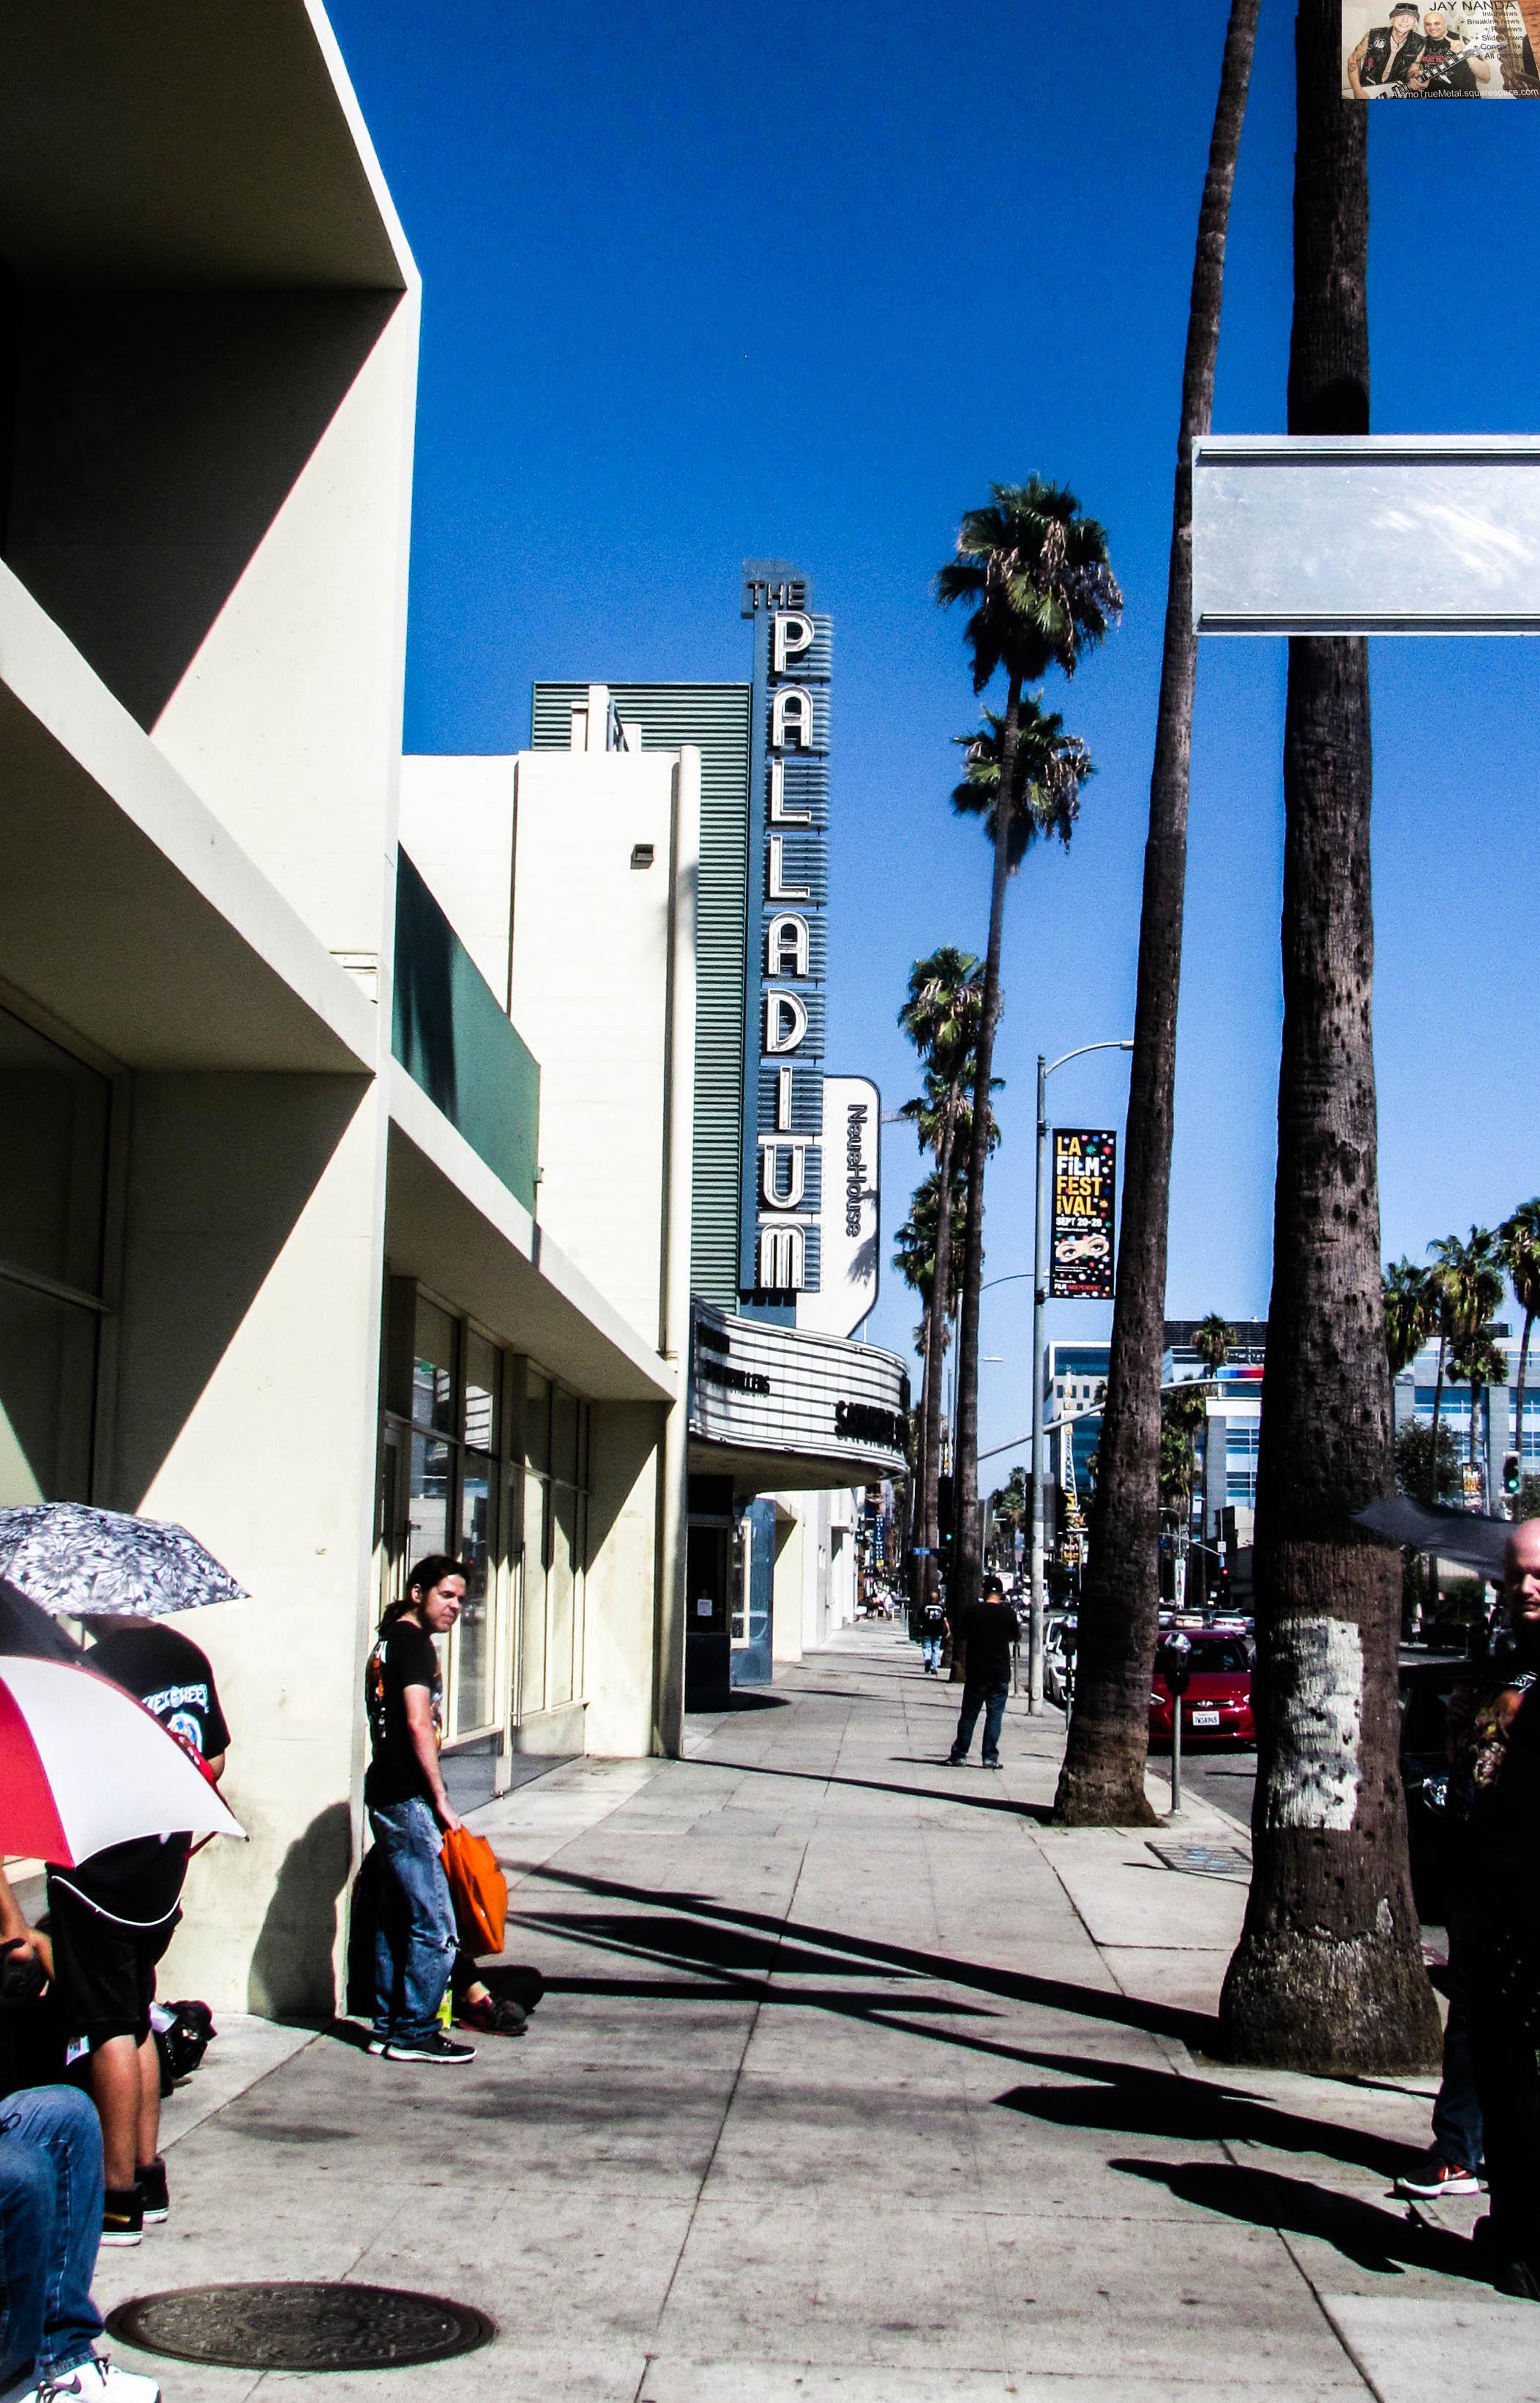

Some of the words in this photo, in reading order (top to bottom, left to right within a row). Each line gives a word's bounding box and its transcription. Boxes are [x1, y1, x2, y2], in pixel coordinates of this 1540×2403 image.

[747, 580, 805, 609] THE
[760, 610, 815, 1289] PALLADIUM
[1057, 1136, 1082, 1155] LA
[846, 1103, 867, 1237] NeueHouse
[1056, 1176, 1103, 1196] FEST
[1055, 1216, 1076, 1226] SEPT
